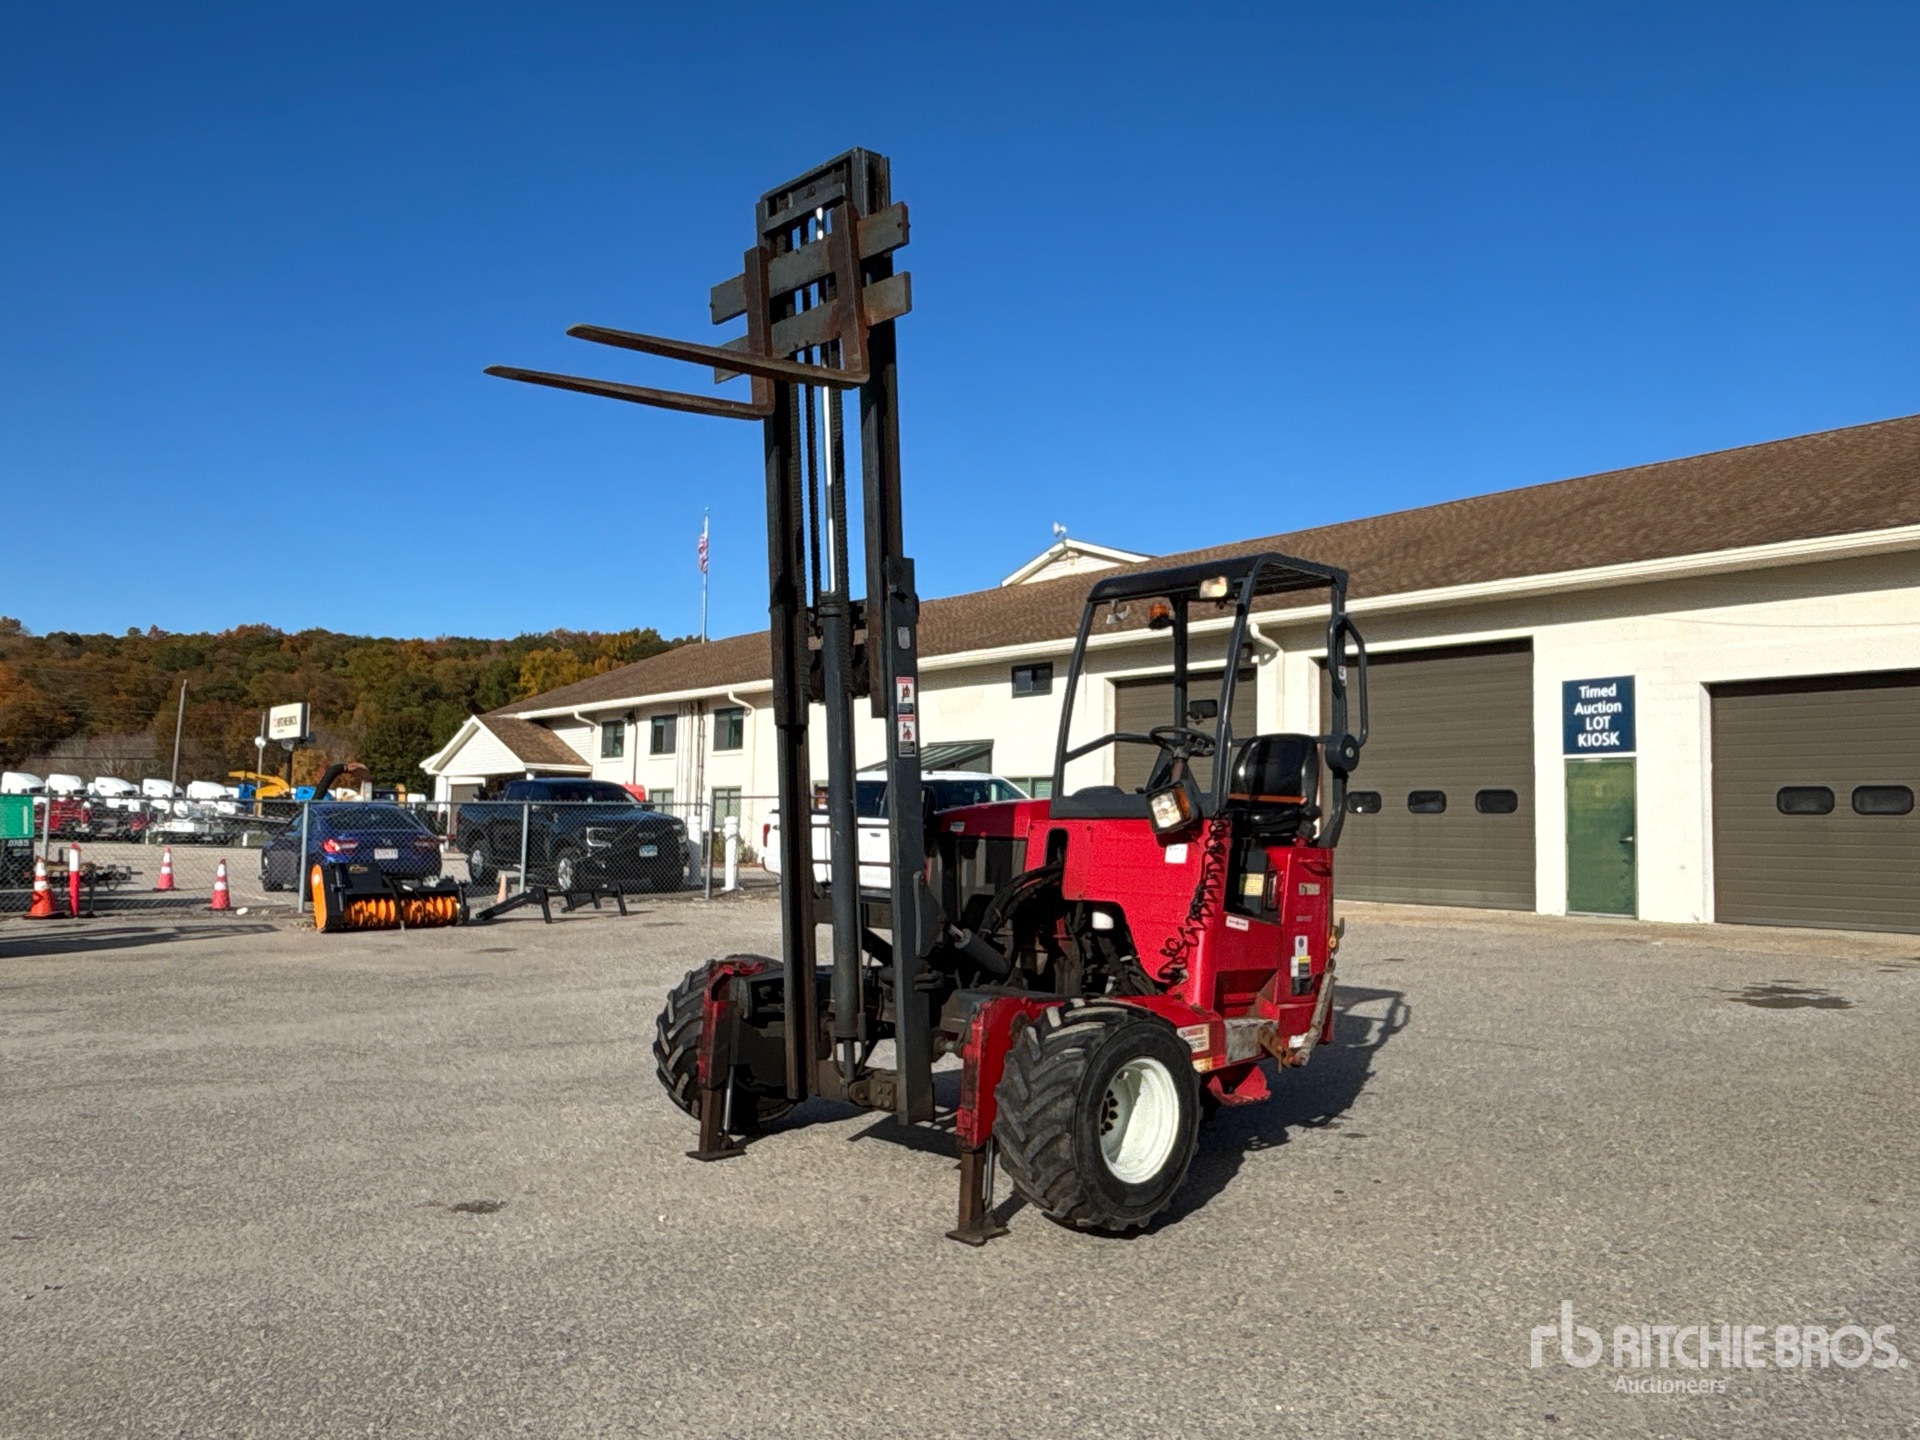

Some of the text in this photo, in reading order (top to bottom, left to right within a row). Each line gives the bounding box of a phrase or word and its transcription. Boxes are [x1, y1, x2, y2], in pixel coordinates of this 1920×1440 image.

[1579, 683, 1617, 699] Timed
[1574, 700, 1622, 715] Auction
[1585, 716, 1611, 731] LOT
[1577, 731, 1620, 747] KIOSK
